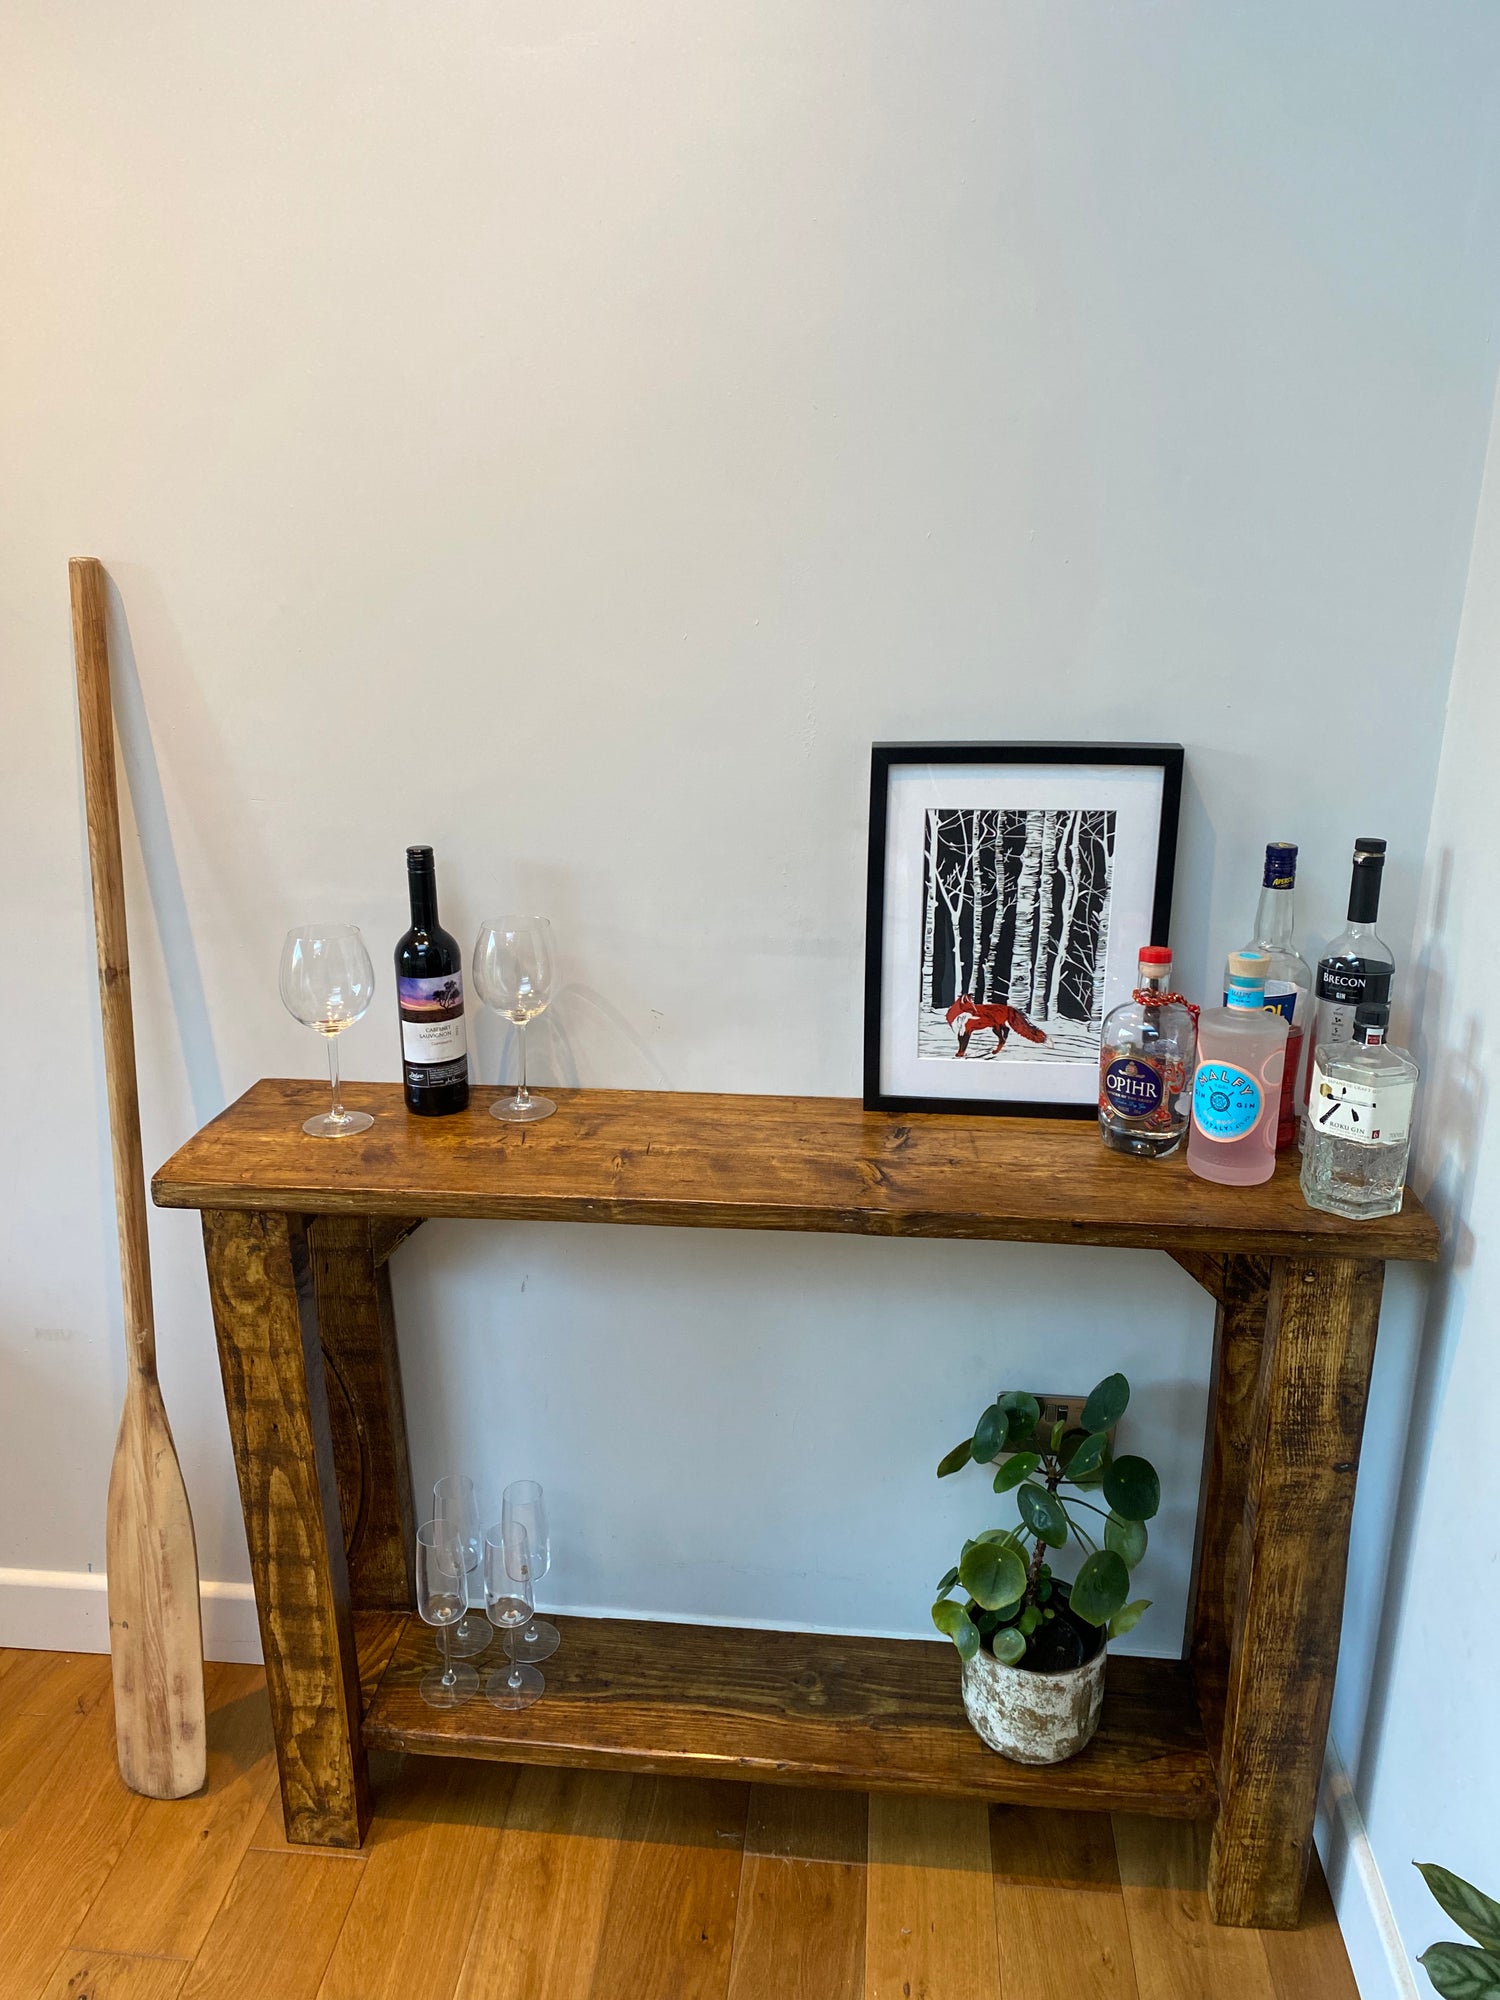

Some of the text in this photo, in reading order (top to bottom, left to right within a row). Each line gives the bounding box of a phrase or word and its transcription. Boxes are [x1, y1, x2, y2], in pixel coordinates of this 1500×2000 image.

[1323, 972, 1367, 988] BRECON
[1335, 992, 1346, 1000] GIN
[1106, 1074, 1158, 1098] OPIHR
[1198, 1069, 1254, 1095] MALFY
[1329, 1121, 1366, 1135] ROKU GIN
